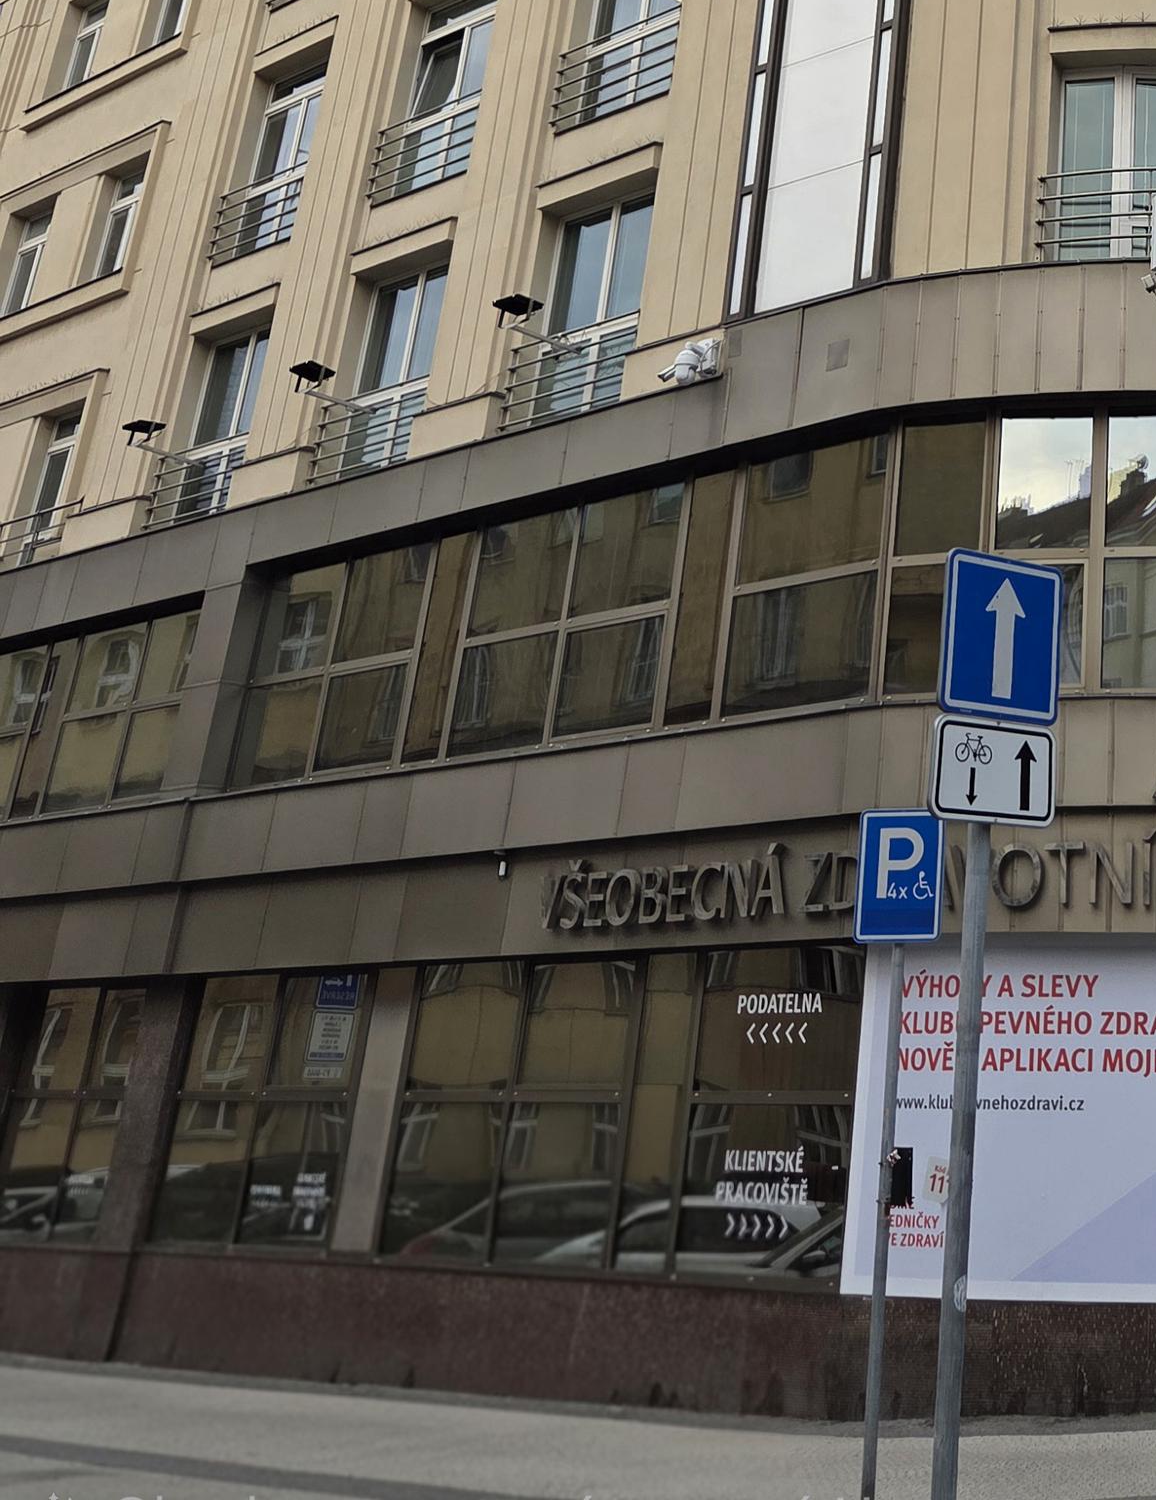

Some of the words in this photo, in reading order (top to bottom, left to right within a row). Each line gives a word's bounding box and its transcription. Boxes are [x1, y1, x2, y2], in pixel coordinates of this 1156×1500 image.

[876, 827, 925, 898] P
[540, 842, 787, 930] VŠEOBECNÁ
[901, 969, 992, 998] VÝHOY
[997, 975, 1014, 997] A
[1021, 974, 1099, 998] SLEVY
[737, 993, 822, 1014] PODATELNA
[900, 1011, 958, 1035] KLUB
[980, 1005, 1092, 1035] PEVNÉHO
[898, 1041, 953, 1071] NOVĚ
[982, 1048, 1093, 1072] APLIKACI
[724, 1146, 804, 1173] KLIENTSKÉ
[715, 1177, 808, 1205] PRACOVIŠTĚ
[890, 1211, 939, 1229] EDNIČKY
[900, 1230, 944, 1247] ZDRAVÍ
